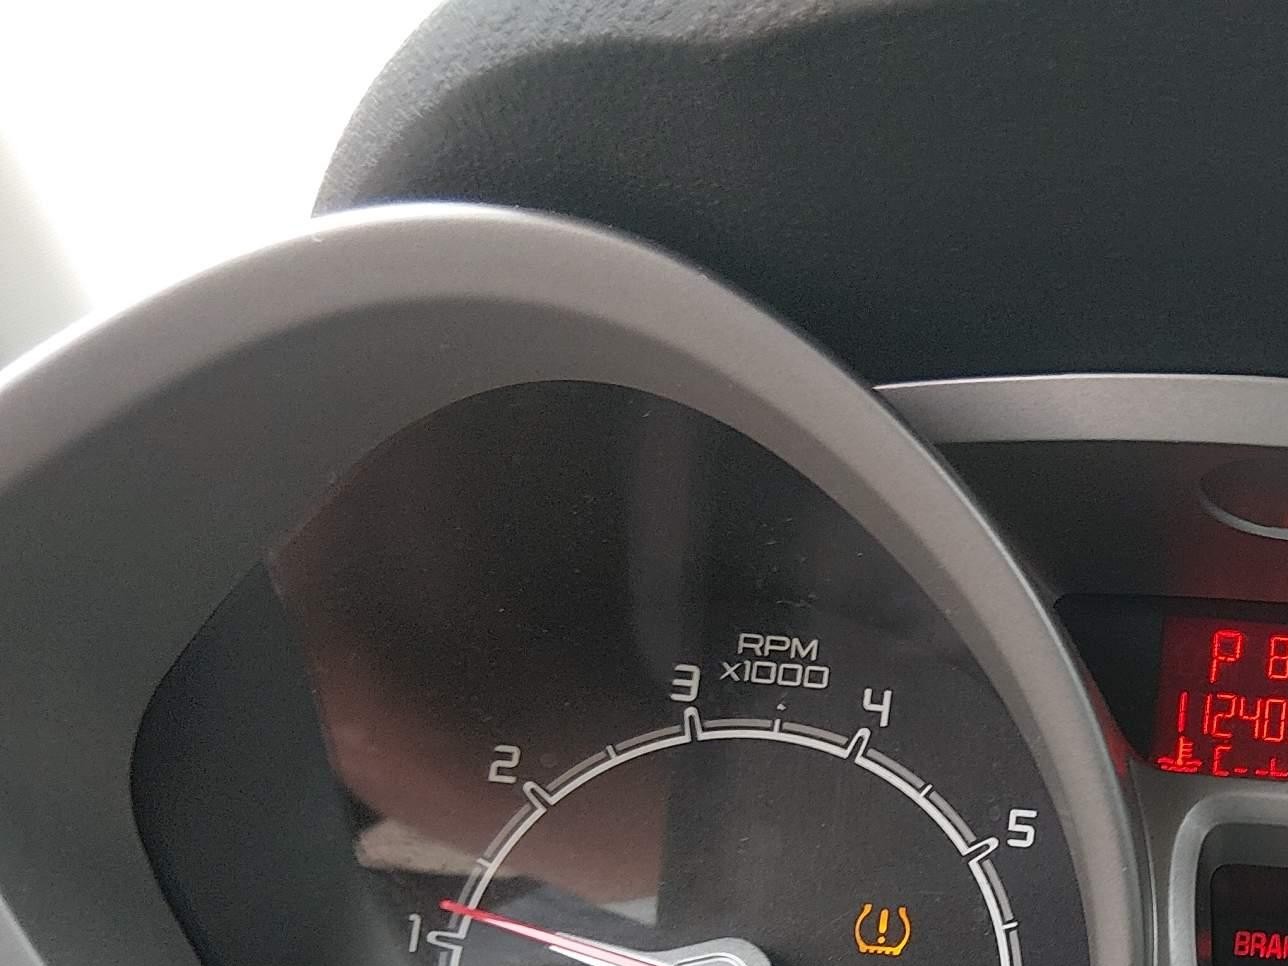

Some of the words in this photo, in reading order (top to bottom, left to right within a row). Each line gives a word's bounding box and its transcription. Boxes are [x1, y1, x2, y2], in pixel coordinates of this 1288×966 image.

[738, 633, 819, 662] RPM
[1210, 630, 1244, 684] P
[670, 664, 701, 702] 3
[862, 688, 893, 728] 4
[488, 745, 521, 783] 2
[1007, 810, 1037, 848] 5
[407, 914, 423, 953] 1
